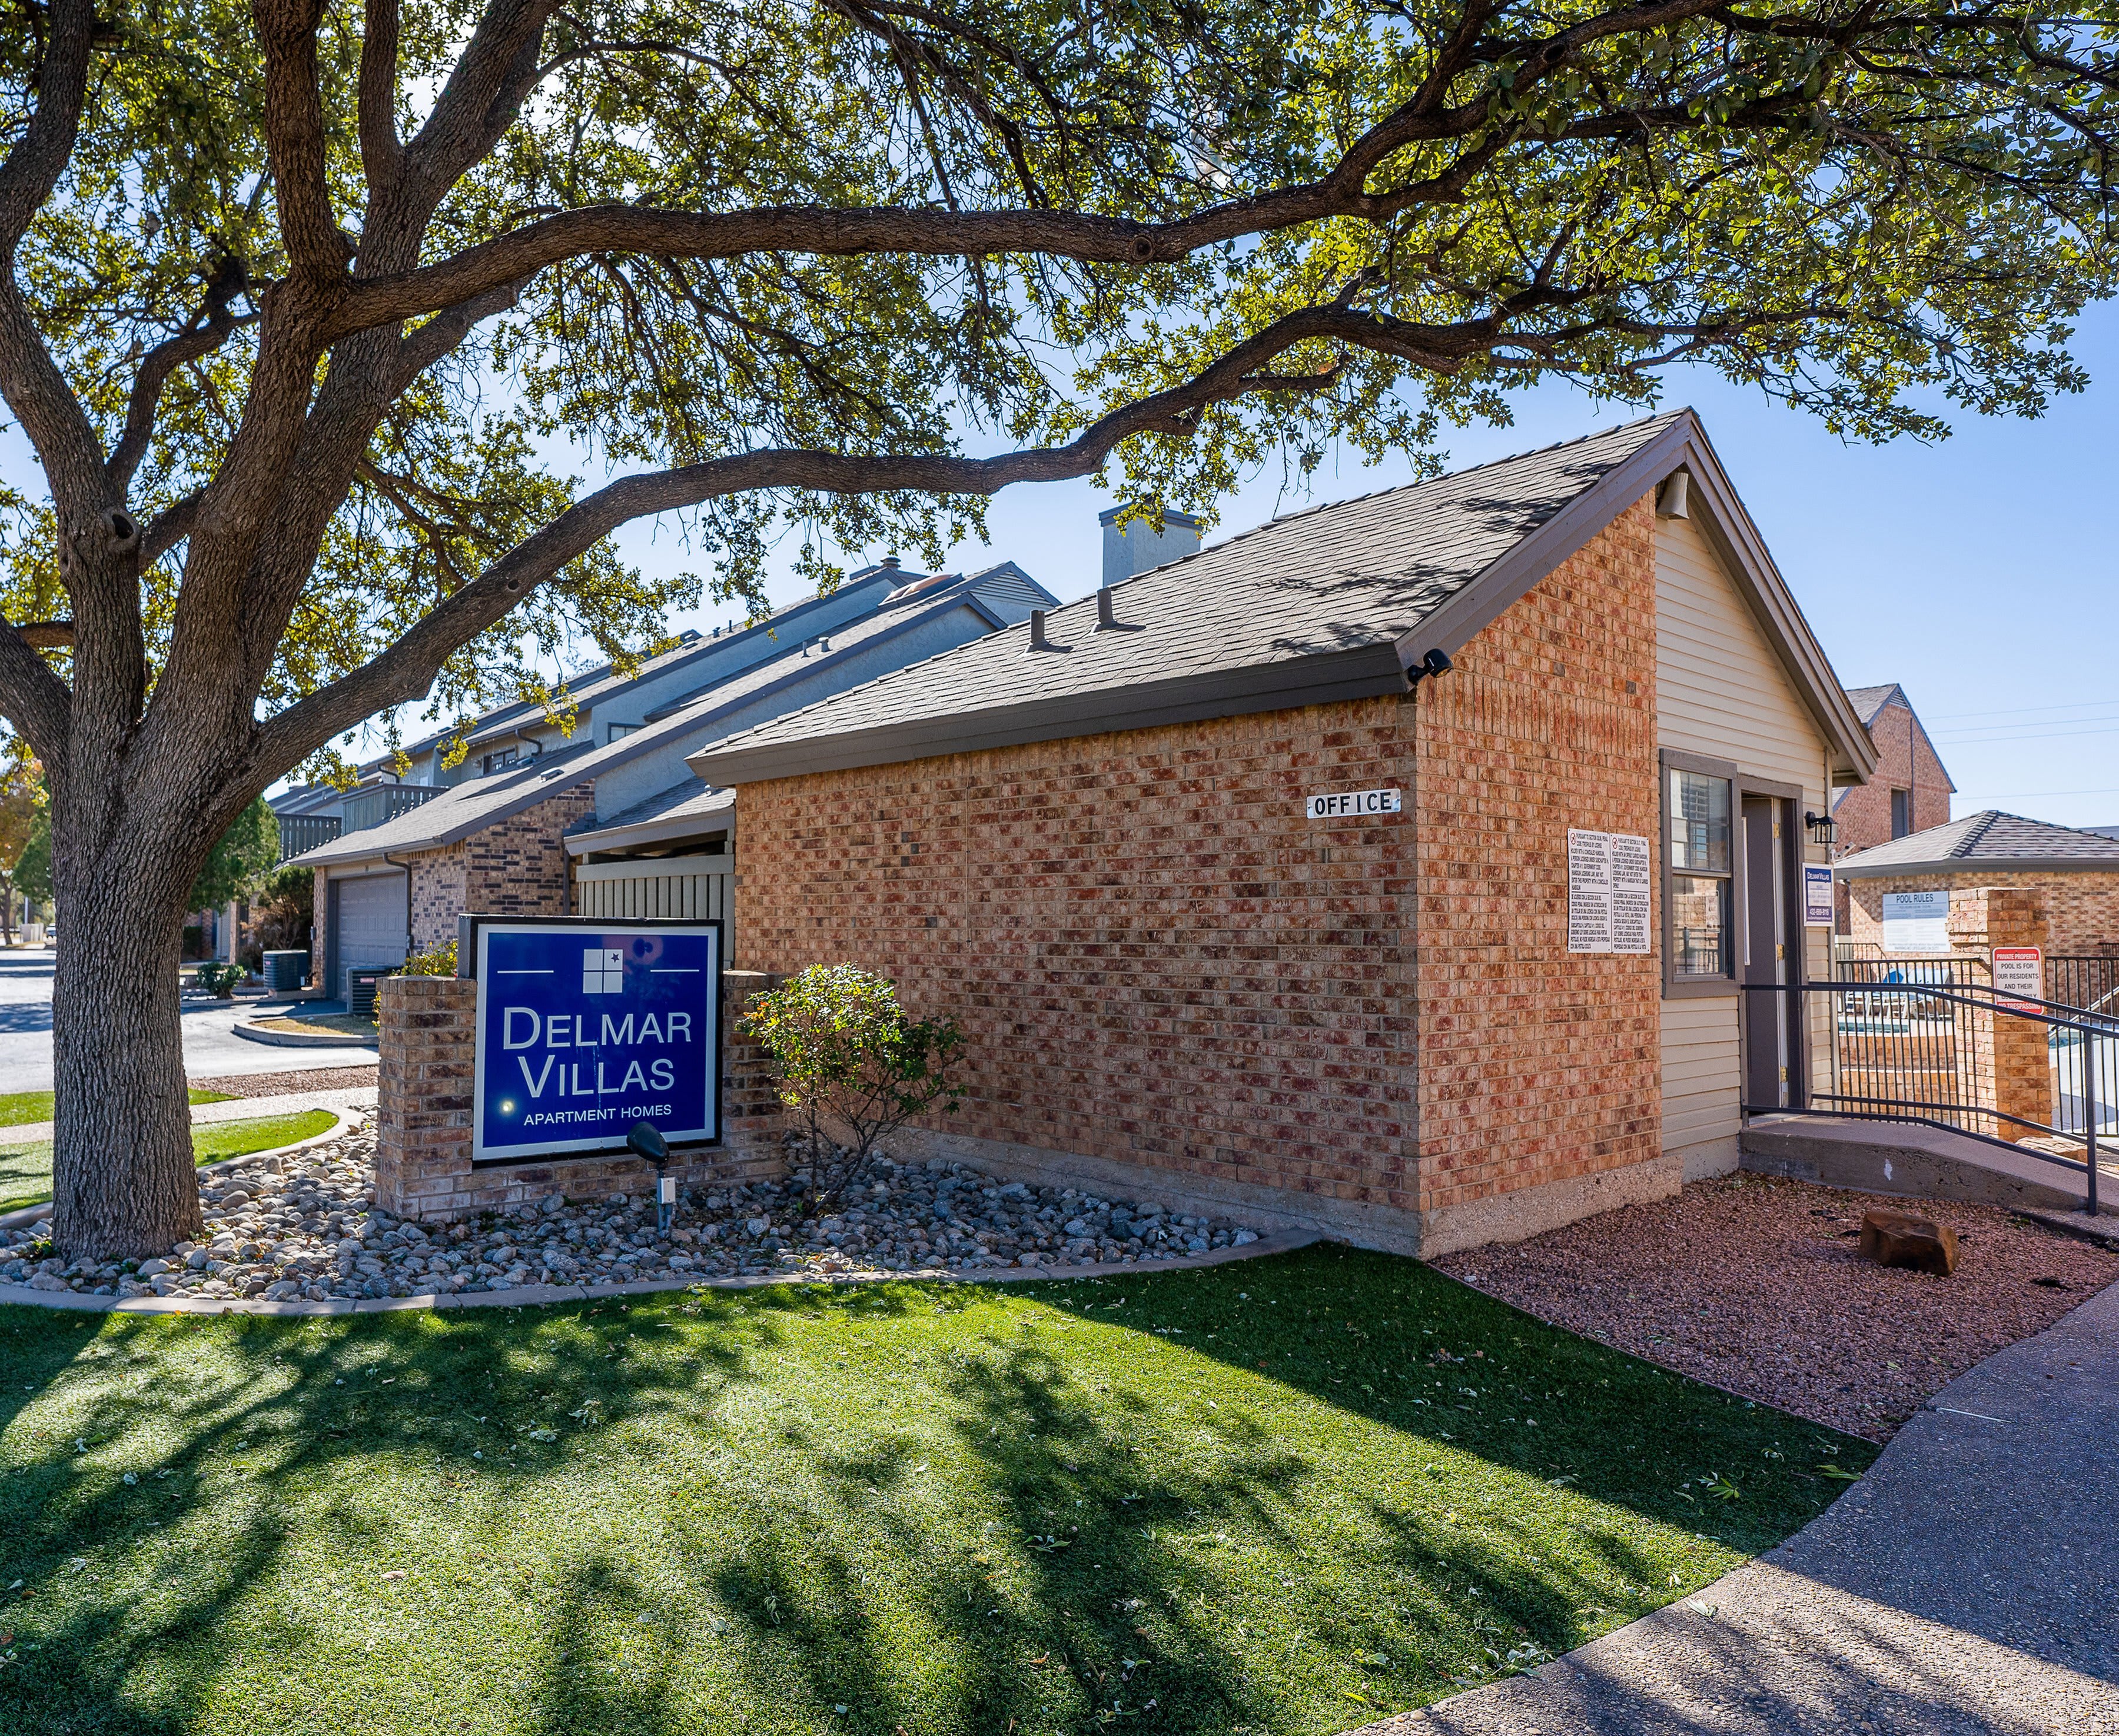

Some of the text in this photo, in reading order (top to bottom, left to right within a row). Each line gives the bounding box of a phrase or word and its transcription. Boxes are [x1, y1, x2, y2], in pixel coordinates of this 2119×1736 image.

[1314, 791, 1391, 815] OFFICE
[1897, 893, 1934, 903] POOL RULES
[503, 1006, 691, 1049] DELMAR
[517, 1055, 675, 1098] VILLAS
[523, 1104, 672, 1126] APARTMENT HOMES
